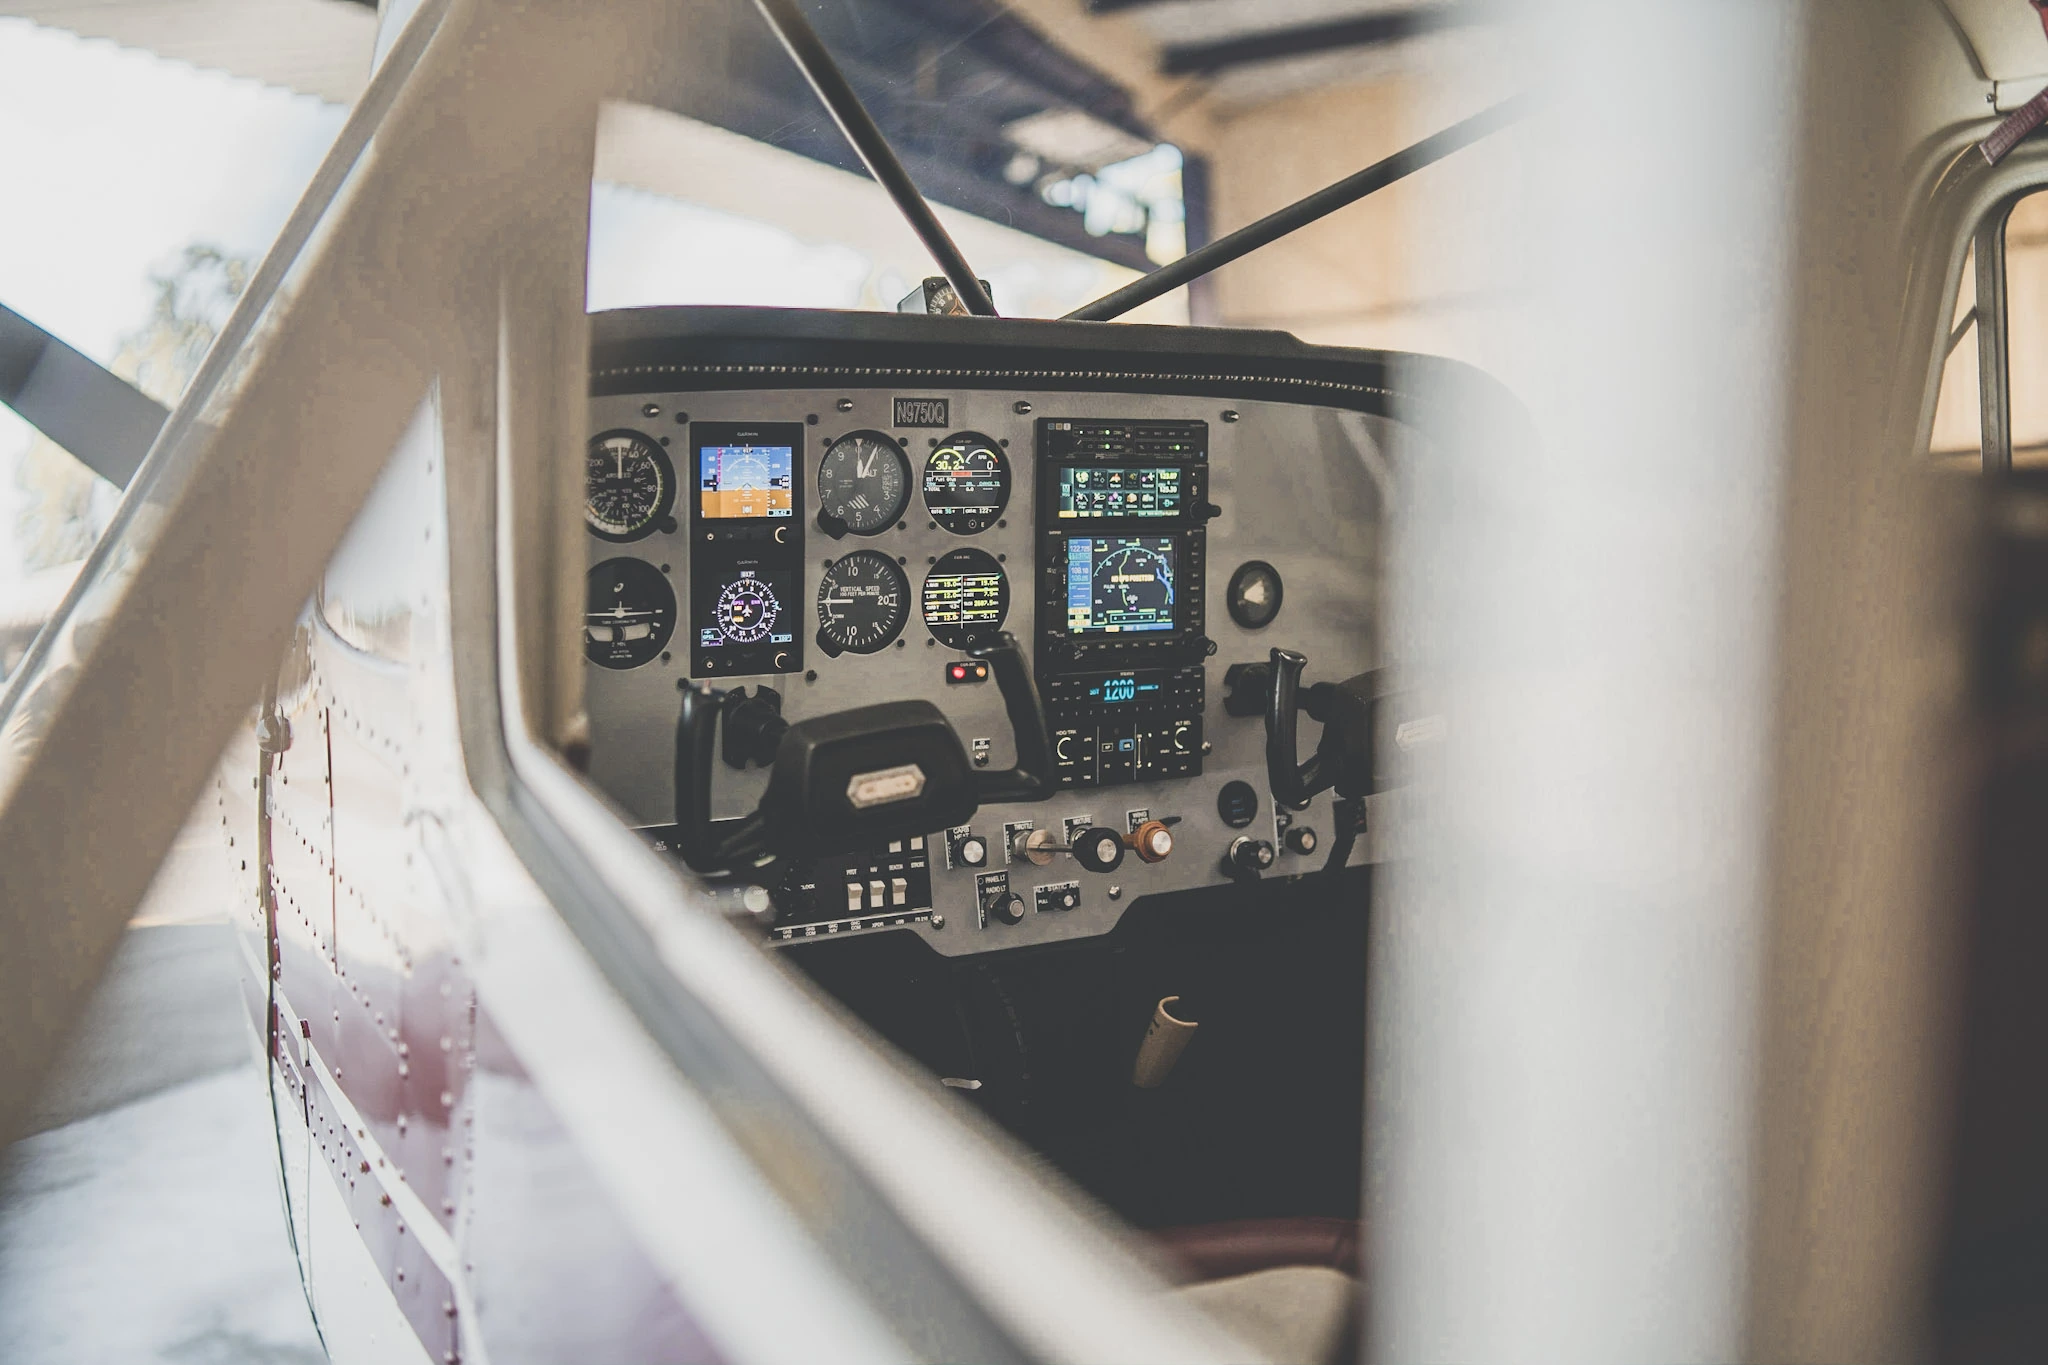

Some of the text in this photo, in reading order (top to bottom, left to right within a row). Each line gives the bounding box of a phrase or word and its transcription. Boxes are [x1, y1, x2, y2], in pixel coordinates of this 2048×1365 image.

[896, 402, 945, 424] N9750Q
[838, 452, 844, 461] 9
[884, 464, 889, 473] 2
[936, 461, 993, 470] 30.2 0
[826, 469, 832, 478] 8
[825, 490, 832, 498] 7
[884, 491, 890, 500] 3
[838, 506, 844, 515] 6
[856, 512, 862, 521] 5
[848, 567, 858, 576] 10
[877, 595, 889, 605] 20
[846, 626, 857, 636] 10
[1104, 679, 1134, 700] 1200
[1073, 817, 1092, 825] MIXTURE
[1048, 883, 1067, 892] STATIC
